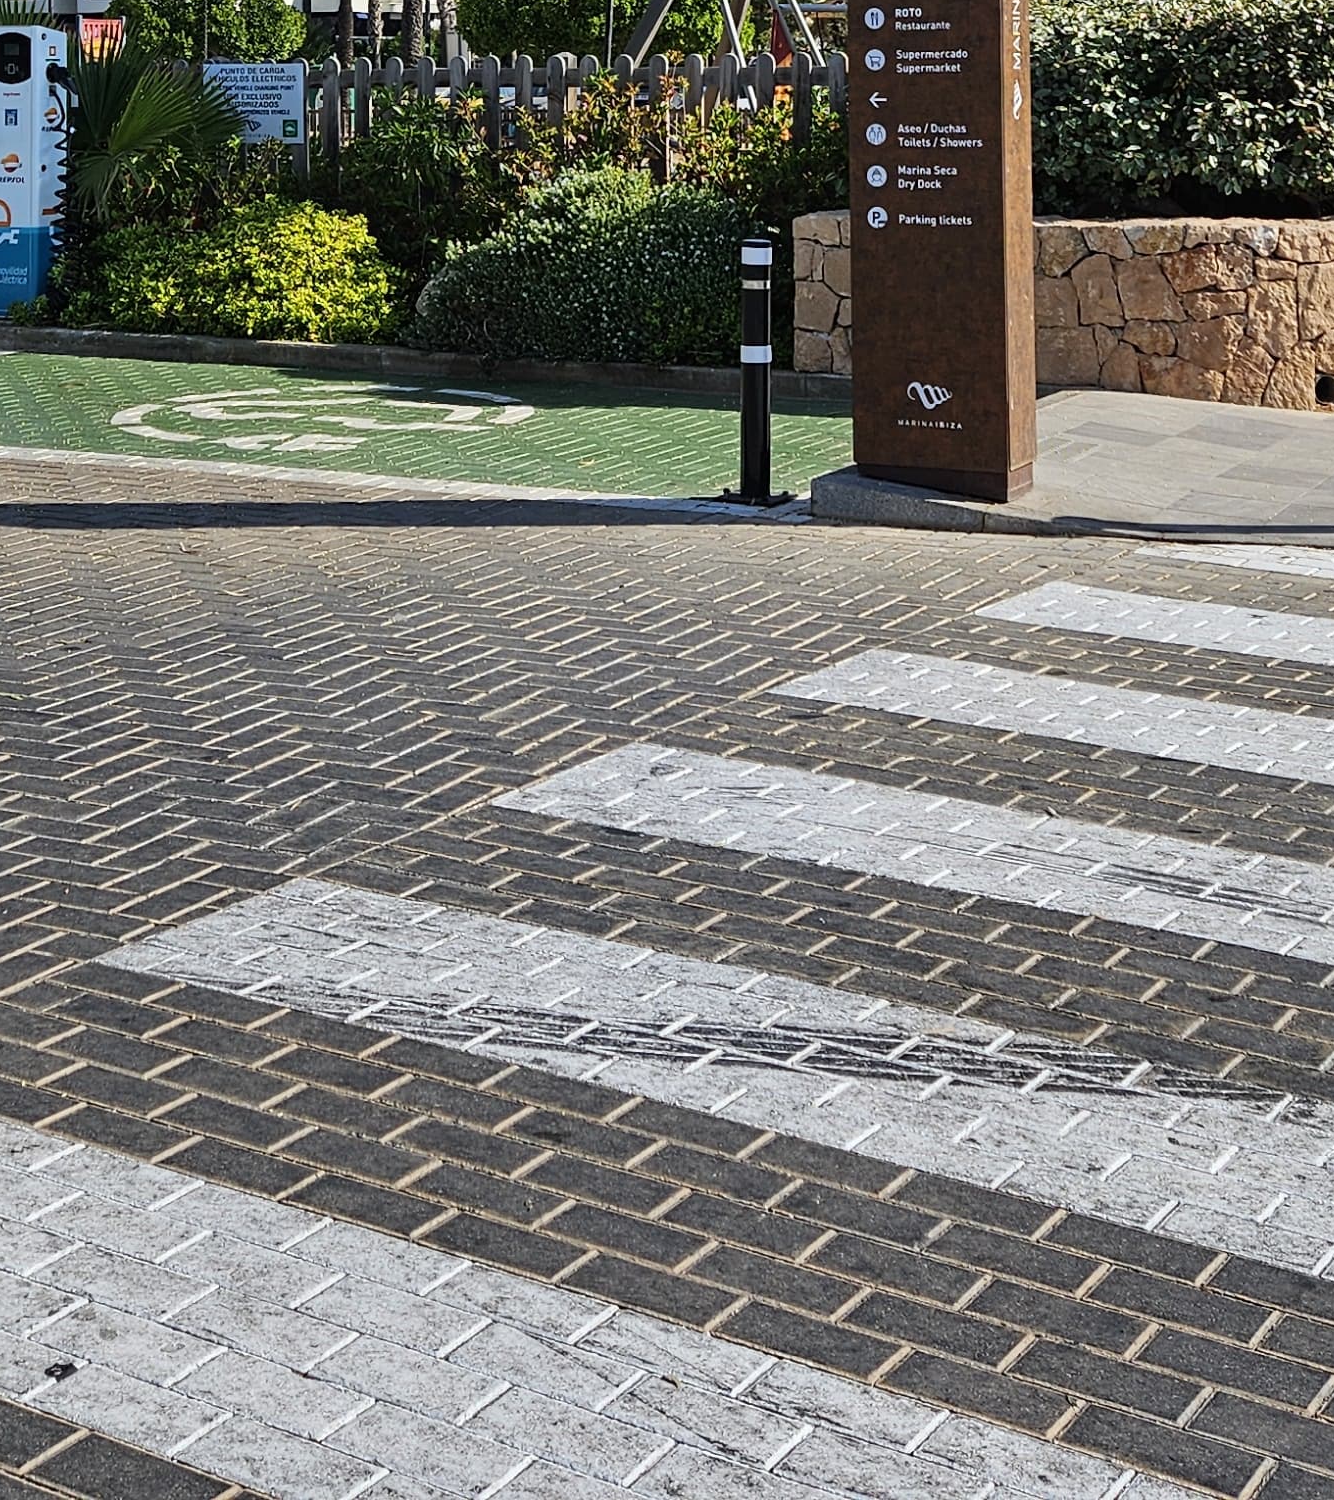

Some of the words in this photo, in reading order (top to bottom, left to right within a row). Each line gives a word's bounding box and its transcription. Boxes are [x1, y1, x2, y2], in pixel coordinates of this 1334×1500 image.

[894, 8, 922, 18] ROTO
[895, 21, 951, 31] Restaurante
[896, 49, 968, 61] Supermercado
[220, 67, 245, 75] PUNTO
[248, 67, 257, 75] DE
[896, 63, 962, 75] Supermarket
[897, 124, 922, 133] Aseo
[930, 123, 967, 133] Duchas
[897, 137, 931, 147] Toilets
[940, 137, 983, 147] Showers
[897, 165, 931, 175] Marina
[934, 165, 958, 175] Seca
[898, 179, 916, 191] Dry
[917, 179, 942, 189] Dock
[898, 214, 936, 227] Parking
[939, 214, 973, 226] tickets
[897, 419, 963, 430] MARINAIBIZA
